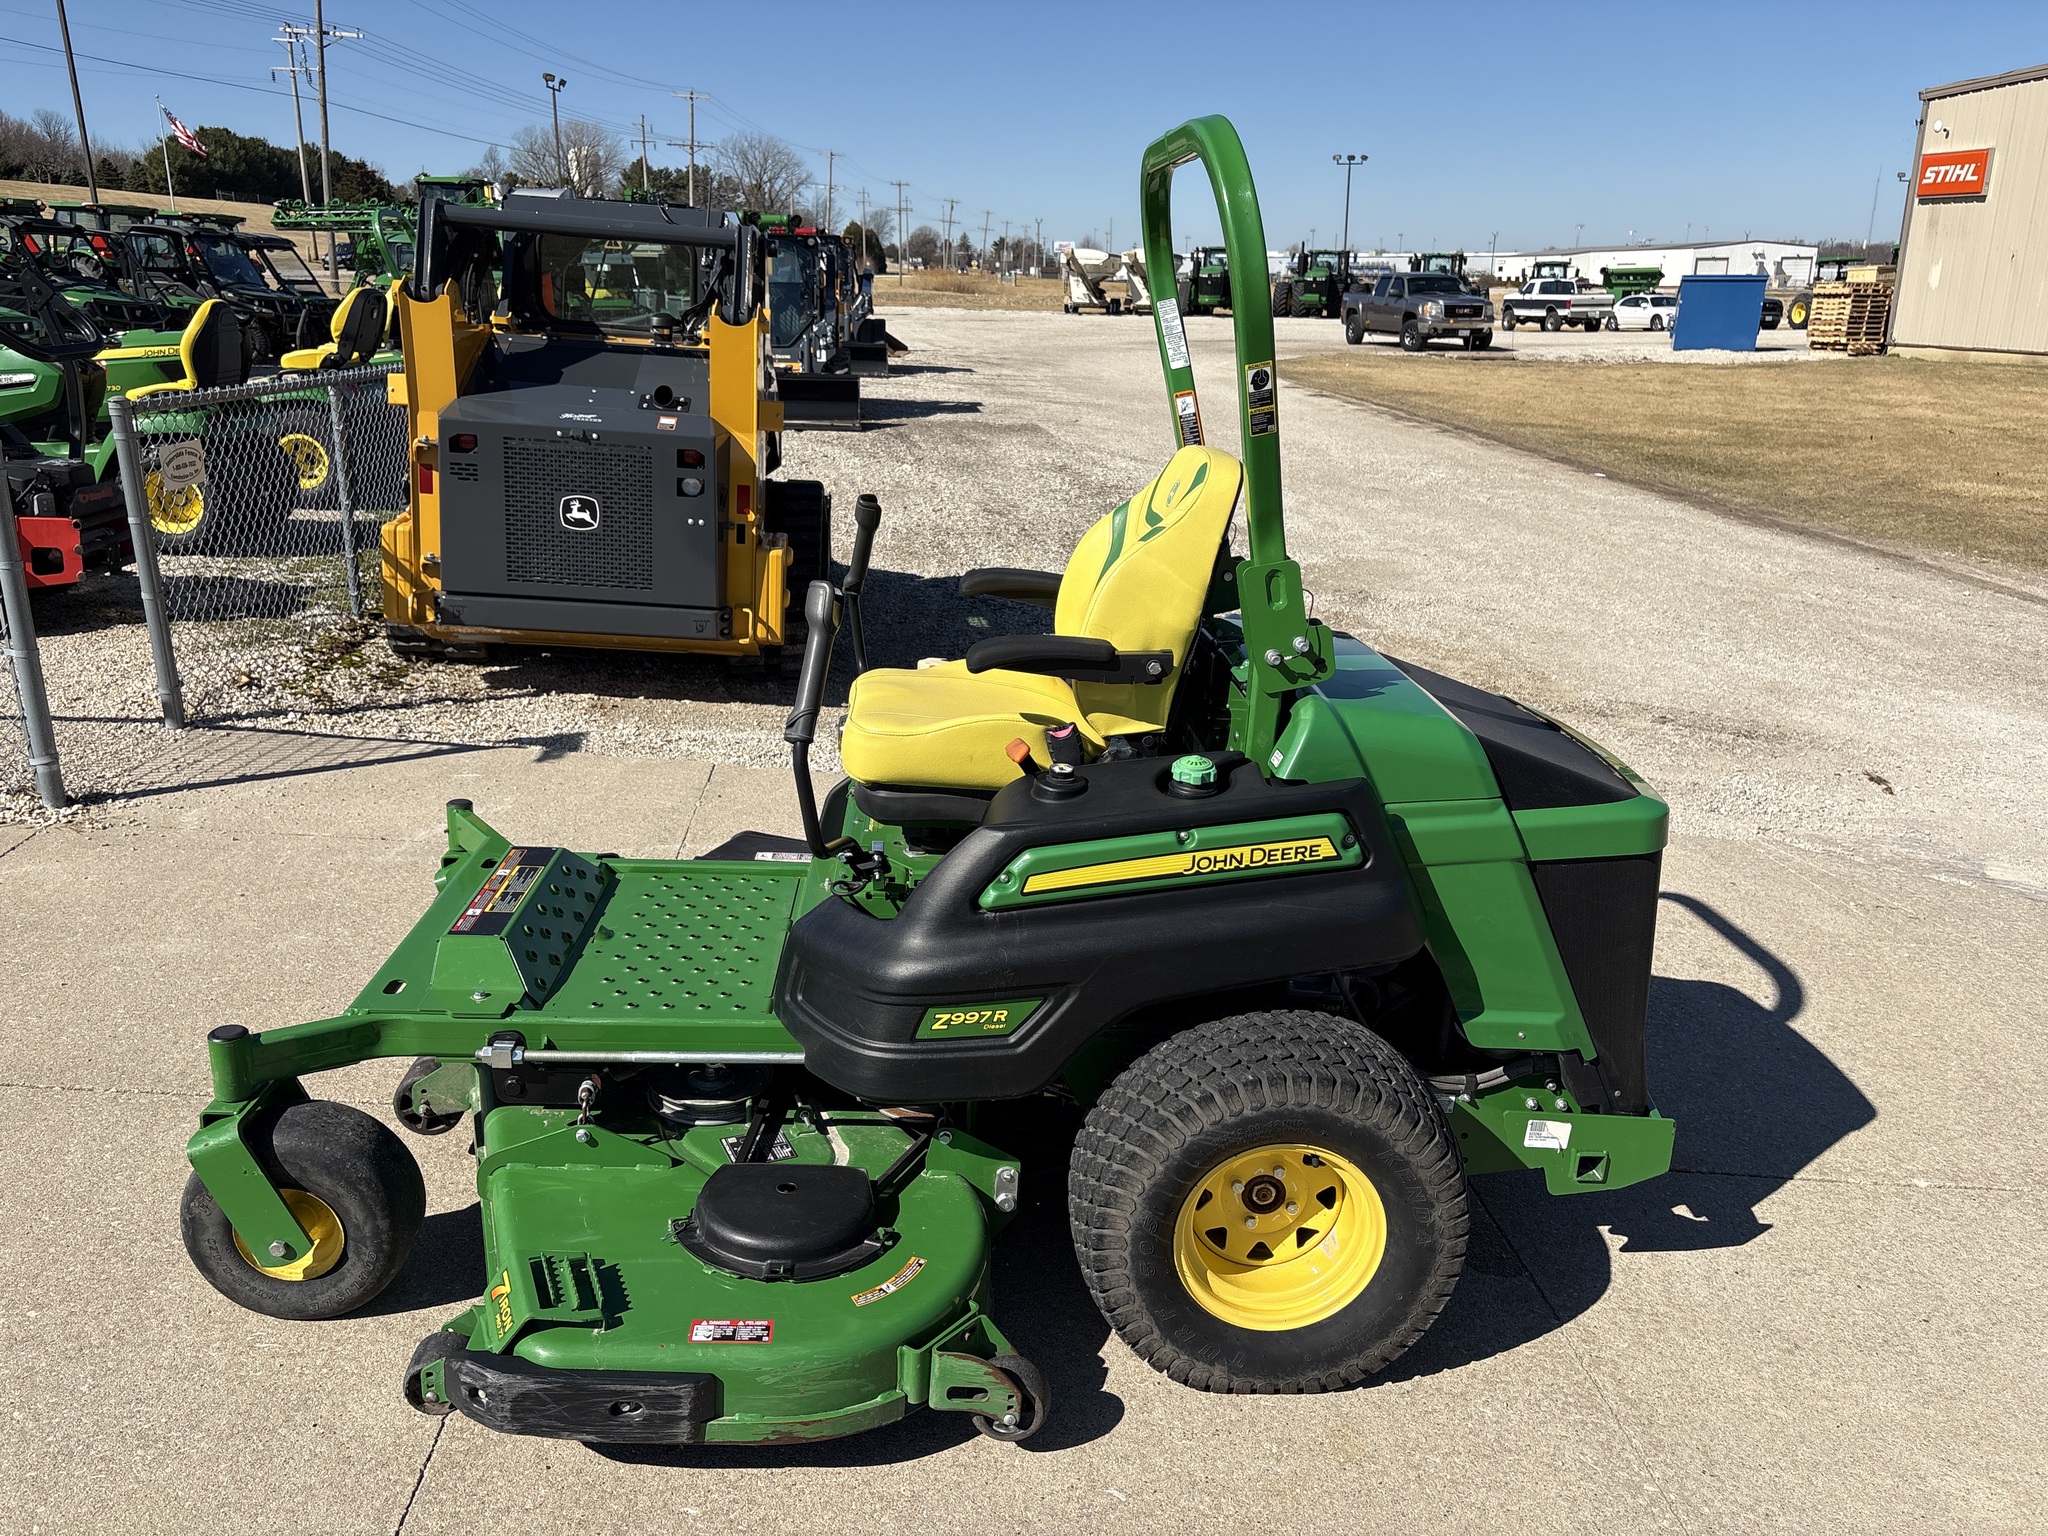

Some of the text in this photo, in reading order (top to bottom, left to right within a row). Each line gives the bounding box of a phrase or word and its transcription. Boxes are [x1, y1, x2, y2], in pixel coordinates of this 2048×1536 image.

[1921, 163, 1979, 184] STIHL
[142, 349, 166, 357] JOHN
[184, 449, 198, 459] Fence
[1183, 844, 1322, 873] JOHN DEERE
[931, 1009, 1009, 1031] Z997R
[983, 1023, 1007, 1031] Diesel
[1377, 1148, 1432, 1245] KENDA
[309, 1250, 377, 1314] CARLISLE
[1154, 1308, 1245, 1369] TURF
